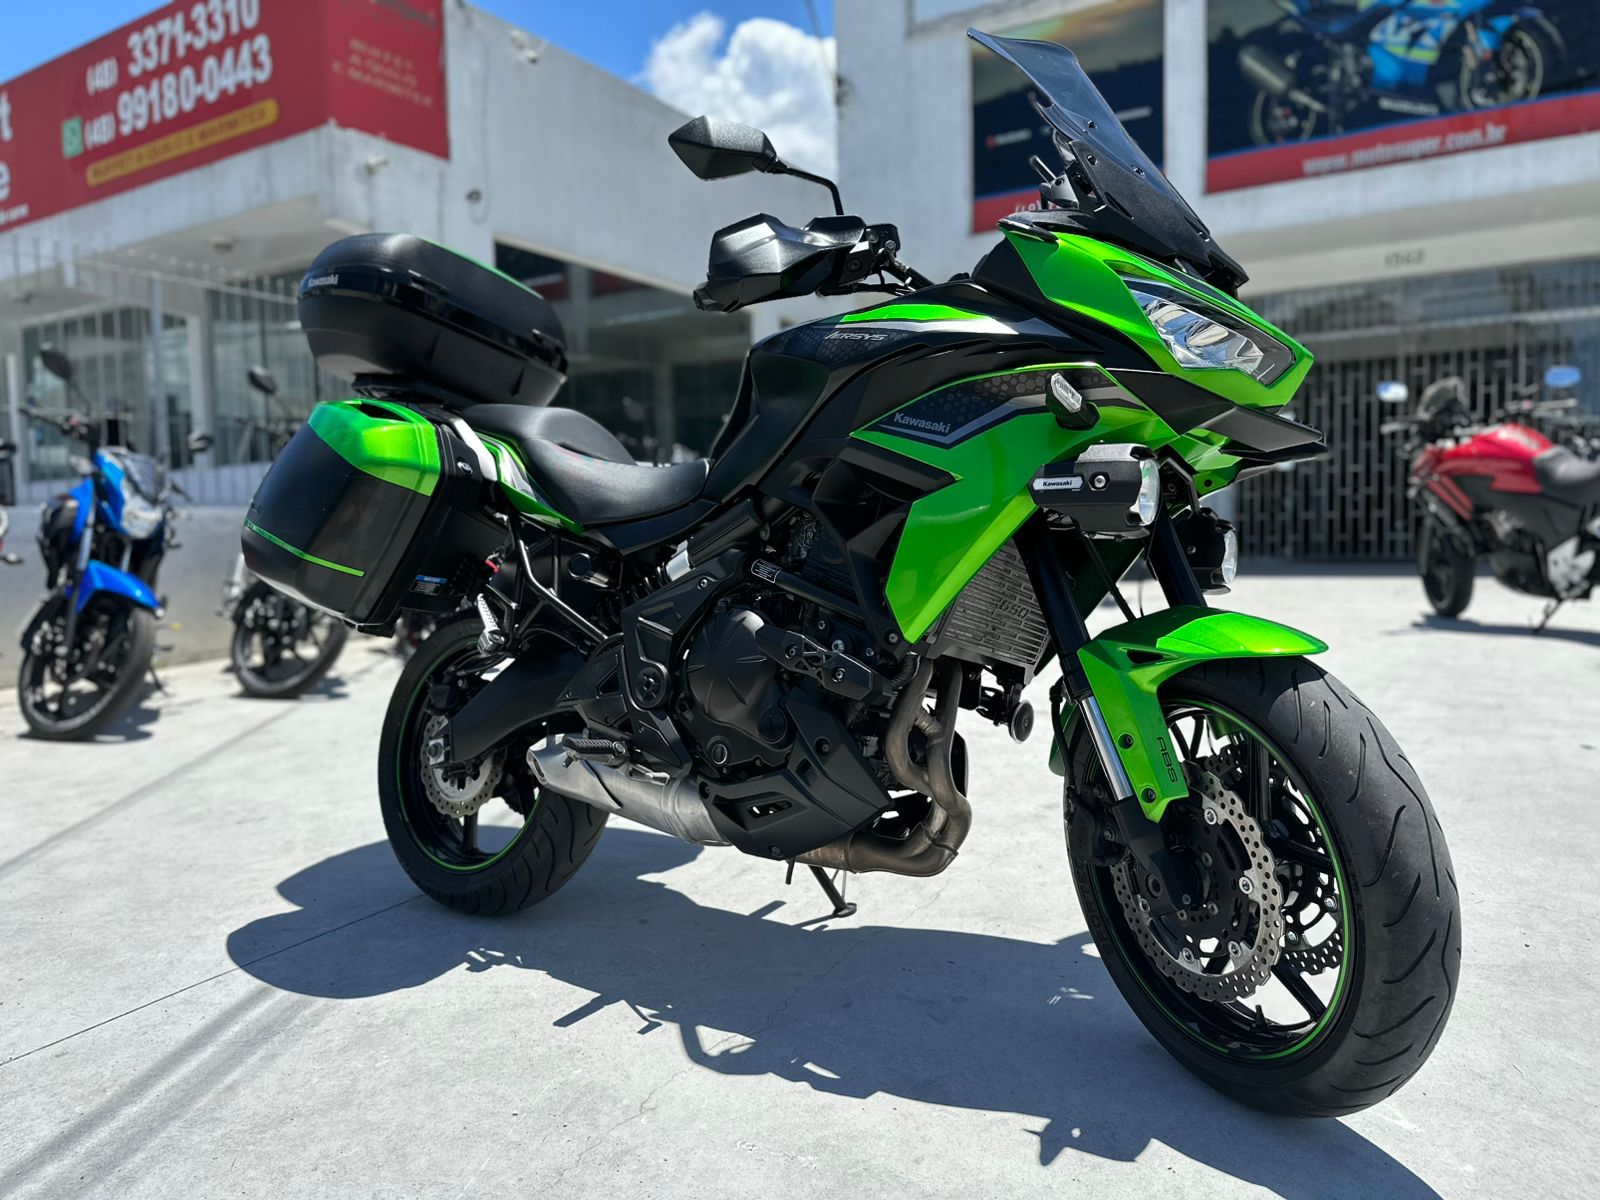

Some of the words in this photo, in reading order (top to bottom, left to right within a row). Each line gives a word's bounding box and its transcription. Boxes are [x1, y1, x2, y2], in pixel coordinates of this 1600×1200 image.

[127, 0, 260, 77] 3371-3310
[117, 33, 272, 136] 99180-0443
[893, 412, 952, 434] Kawasaki
[1156, 736, 1178, 783] ABS
